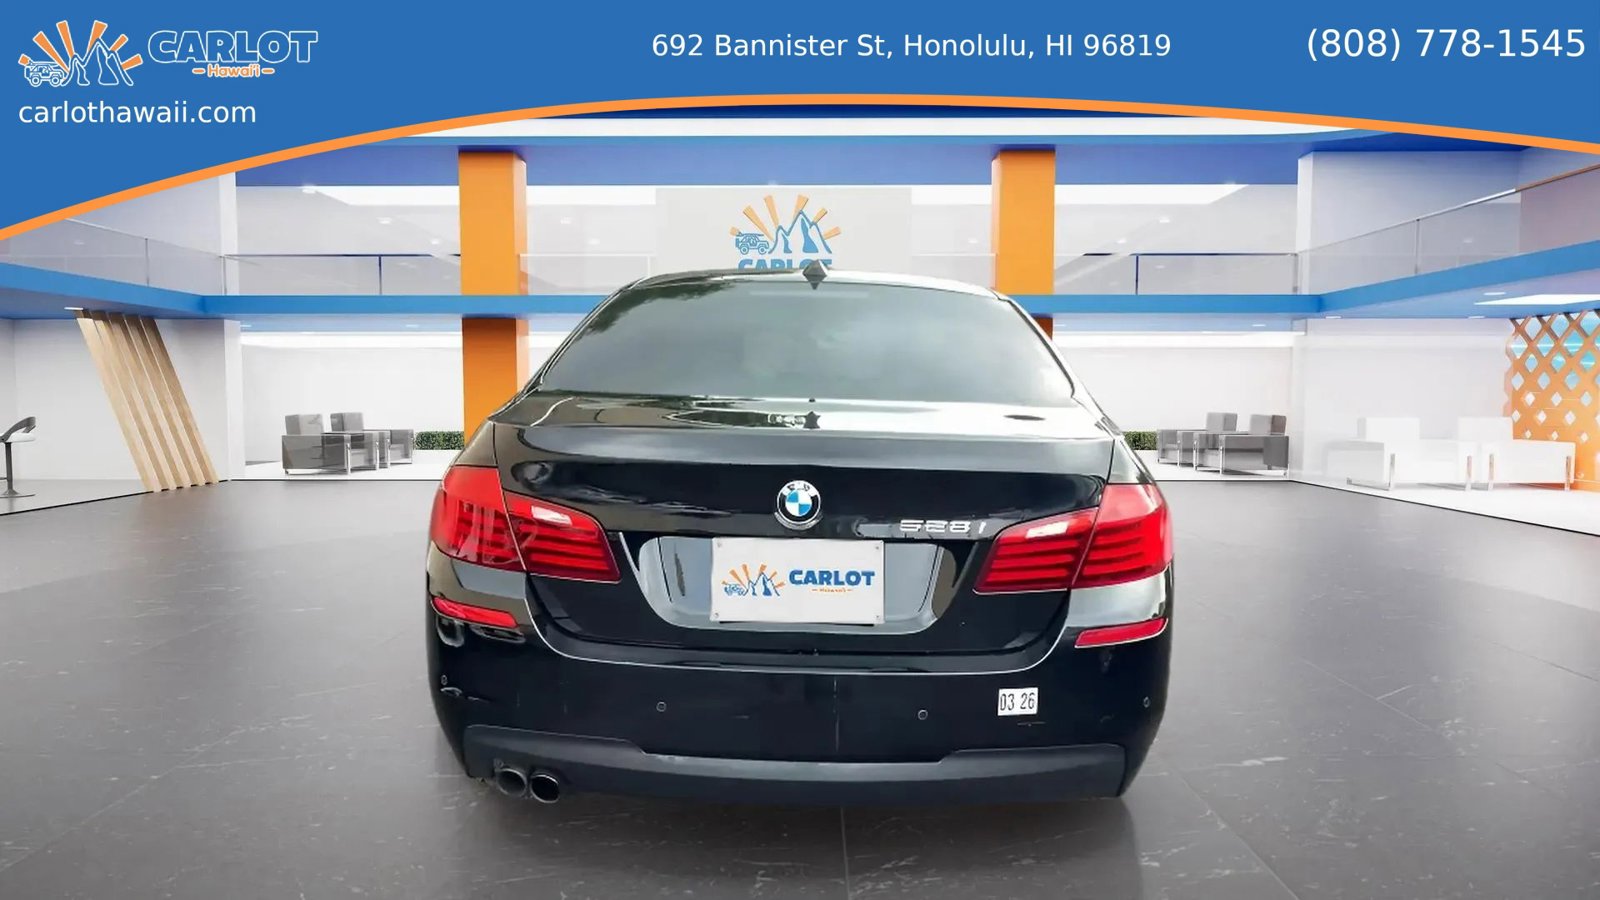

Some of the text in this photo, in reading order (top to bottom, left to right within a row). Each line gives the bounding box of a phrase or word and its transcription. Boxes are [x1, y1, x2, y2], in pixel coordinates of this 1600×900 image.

[789, 569, 876, 586] CARLOT
[1000, 692, 1036, 711] 03 26
